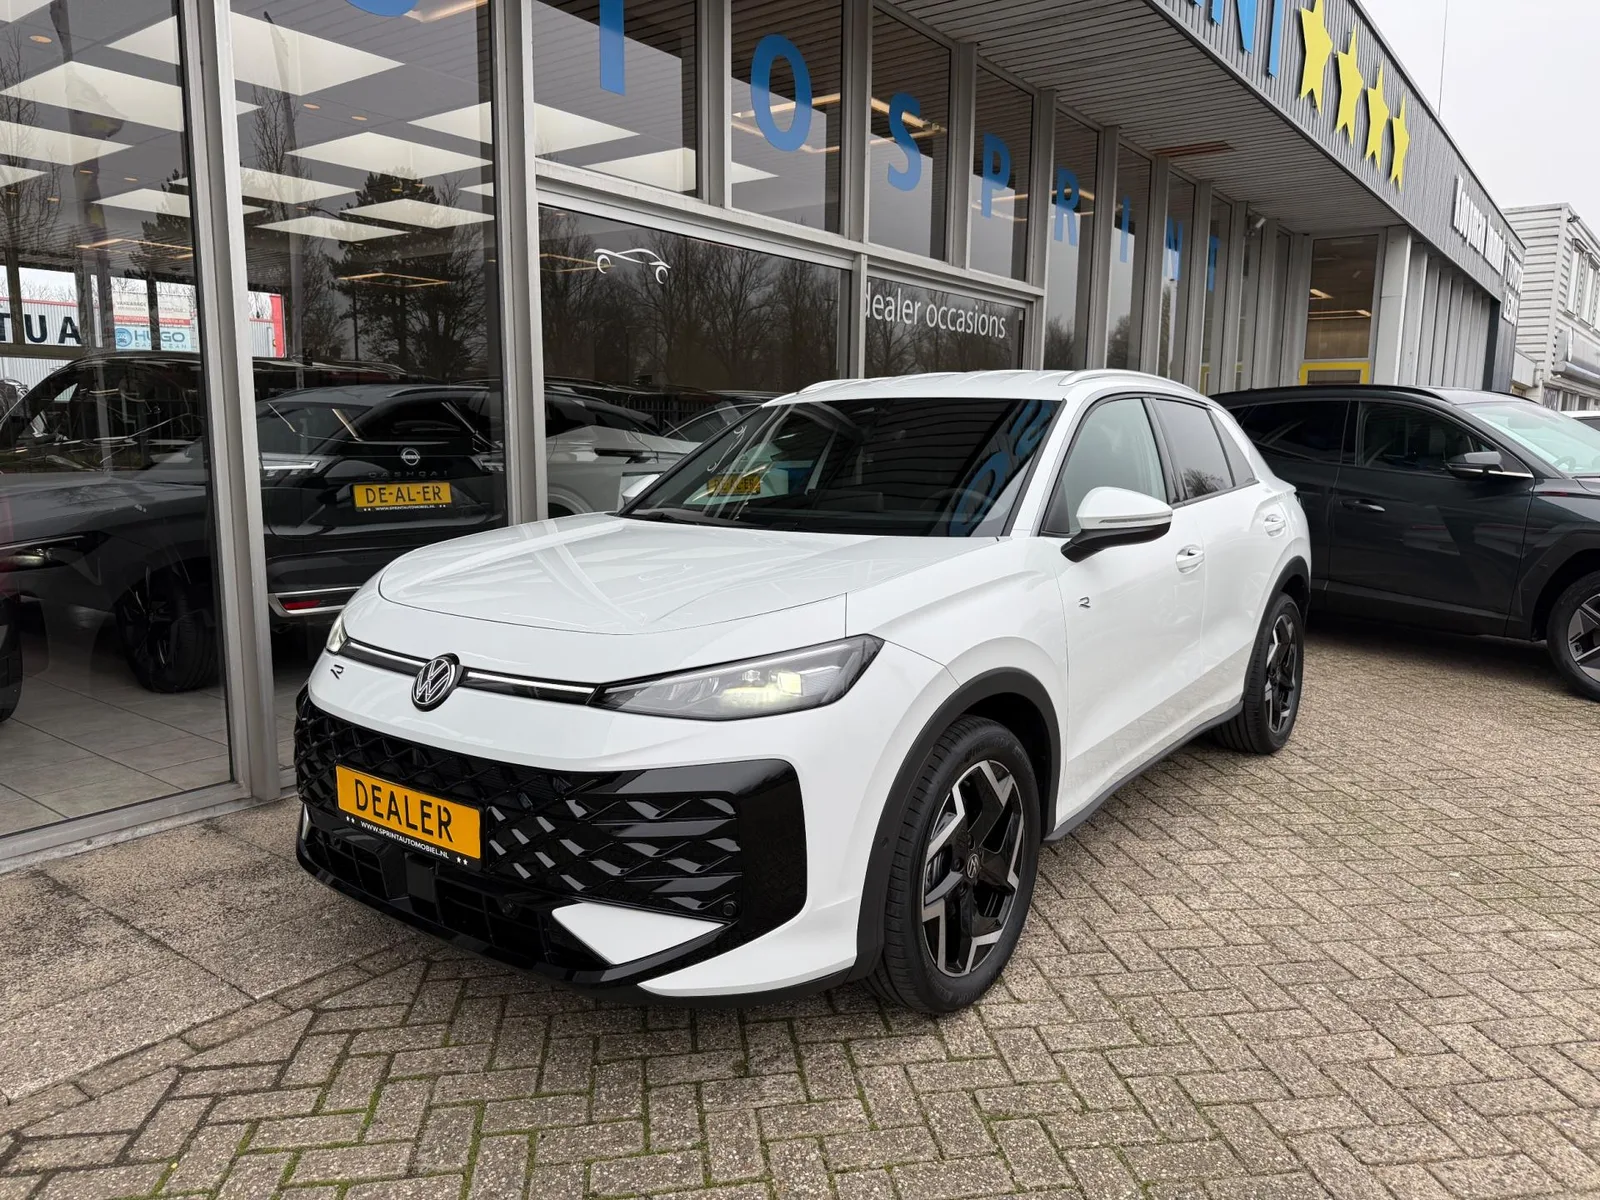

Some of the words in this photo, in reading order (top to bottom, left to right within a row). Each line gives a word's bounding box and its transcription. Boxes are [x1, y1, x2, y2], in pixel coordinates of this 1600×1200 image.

[926, 304, 1006, 339] occasions
[365, 485, 443, 504] DE-AL-ER
[354, 778, 454, 843] DEALER
[360, 821, 450, 859] WWW.SPRINTAUTOMOBIEL.NL
